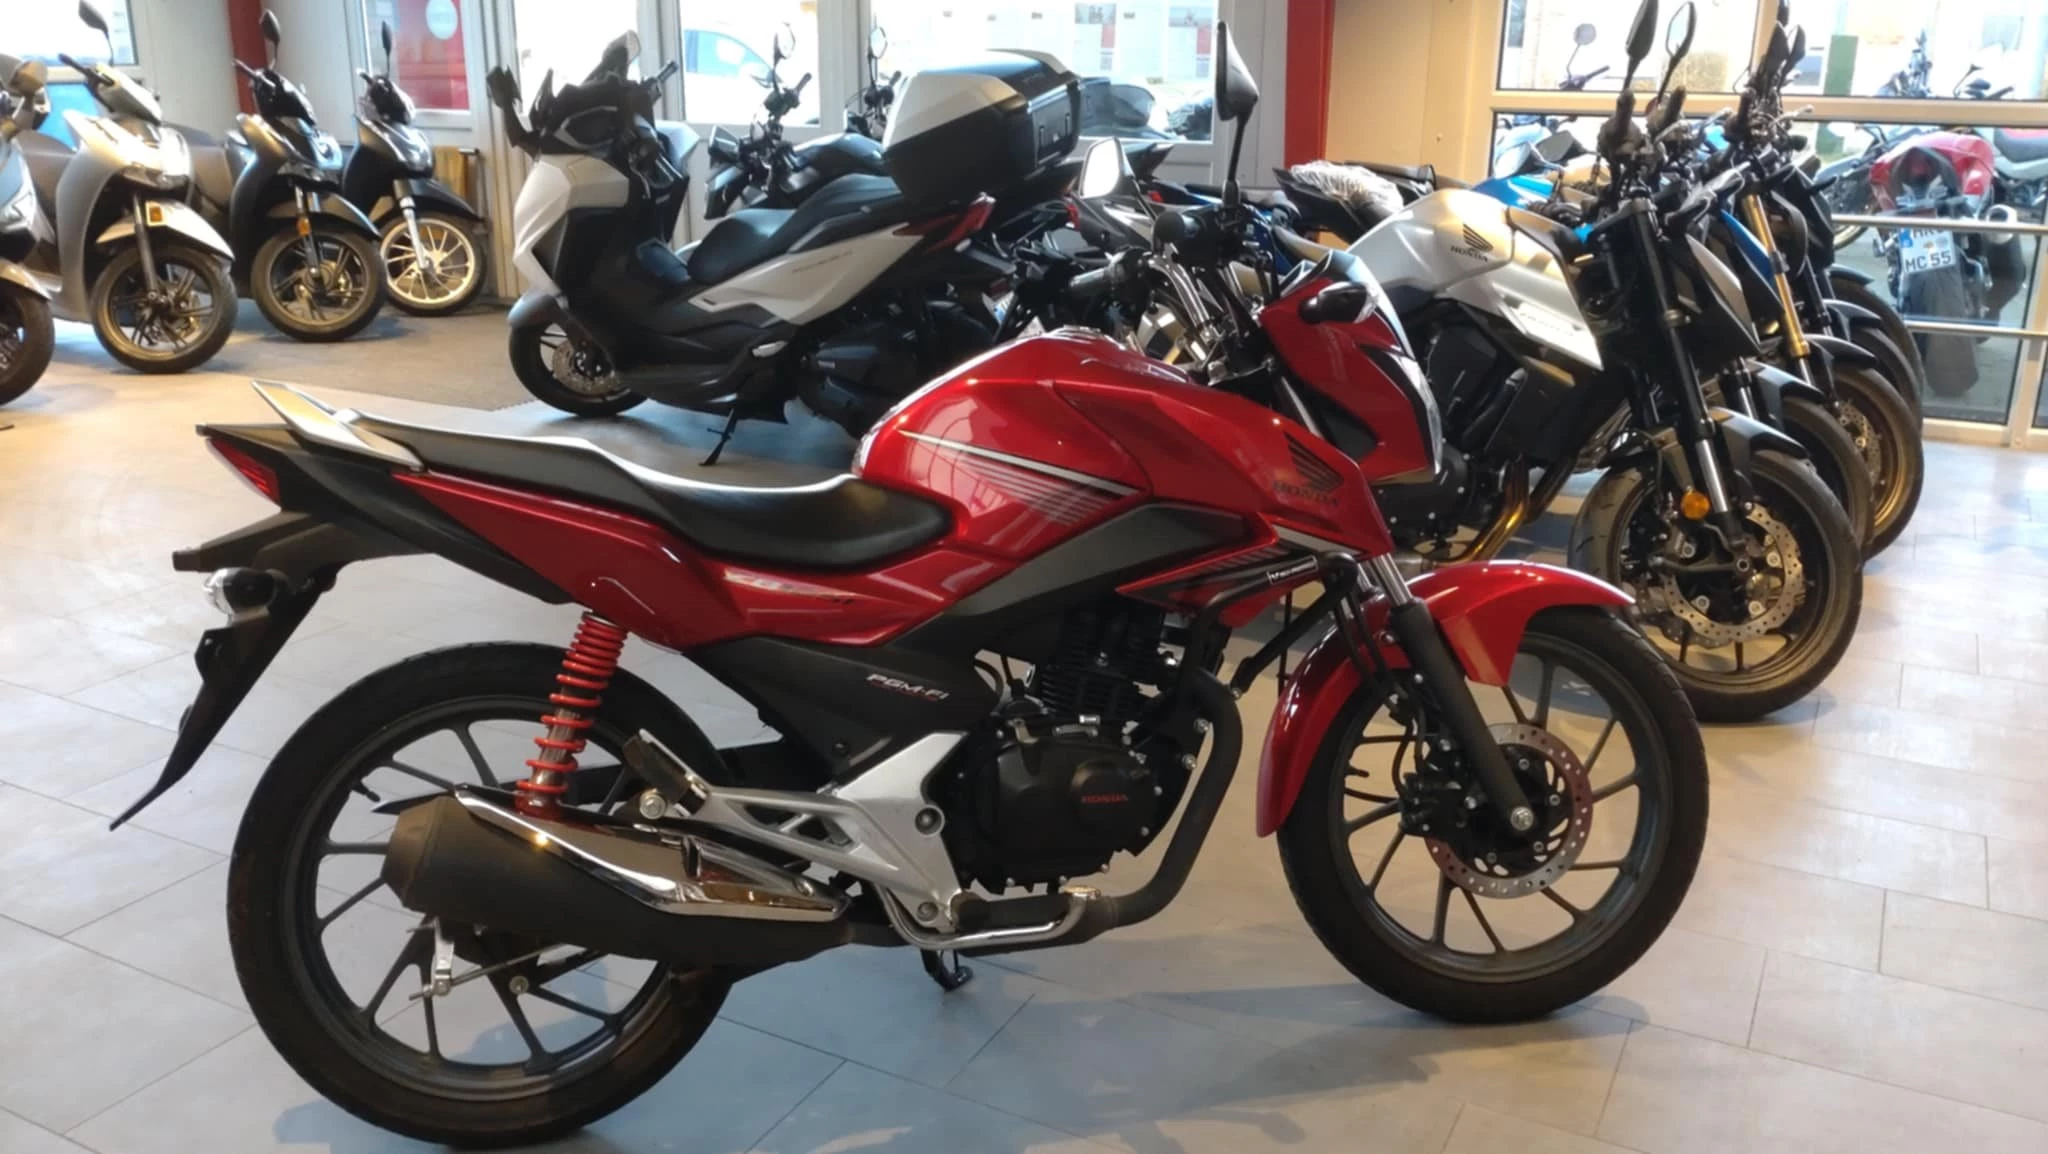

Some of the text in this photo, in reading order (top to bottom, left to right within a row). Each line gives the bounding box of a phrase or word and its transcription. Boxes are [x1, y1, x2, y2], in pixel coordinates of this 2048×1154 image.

[1450, 245, 1489, 263] HONDA
[1904, 250, 1952, 273] MC 55
[1273, 480, 1339, 507] HONDA
[867, 673, 950, 701] PGM-FI
[1081, 793, 1129, 805] HONDA
